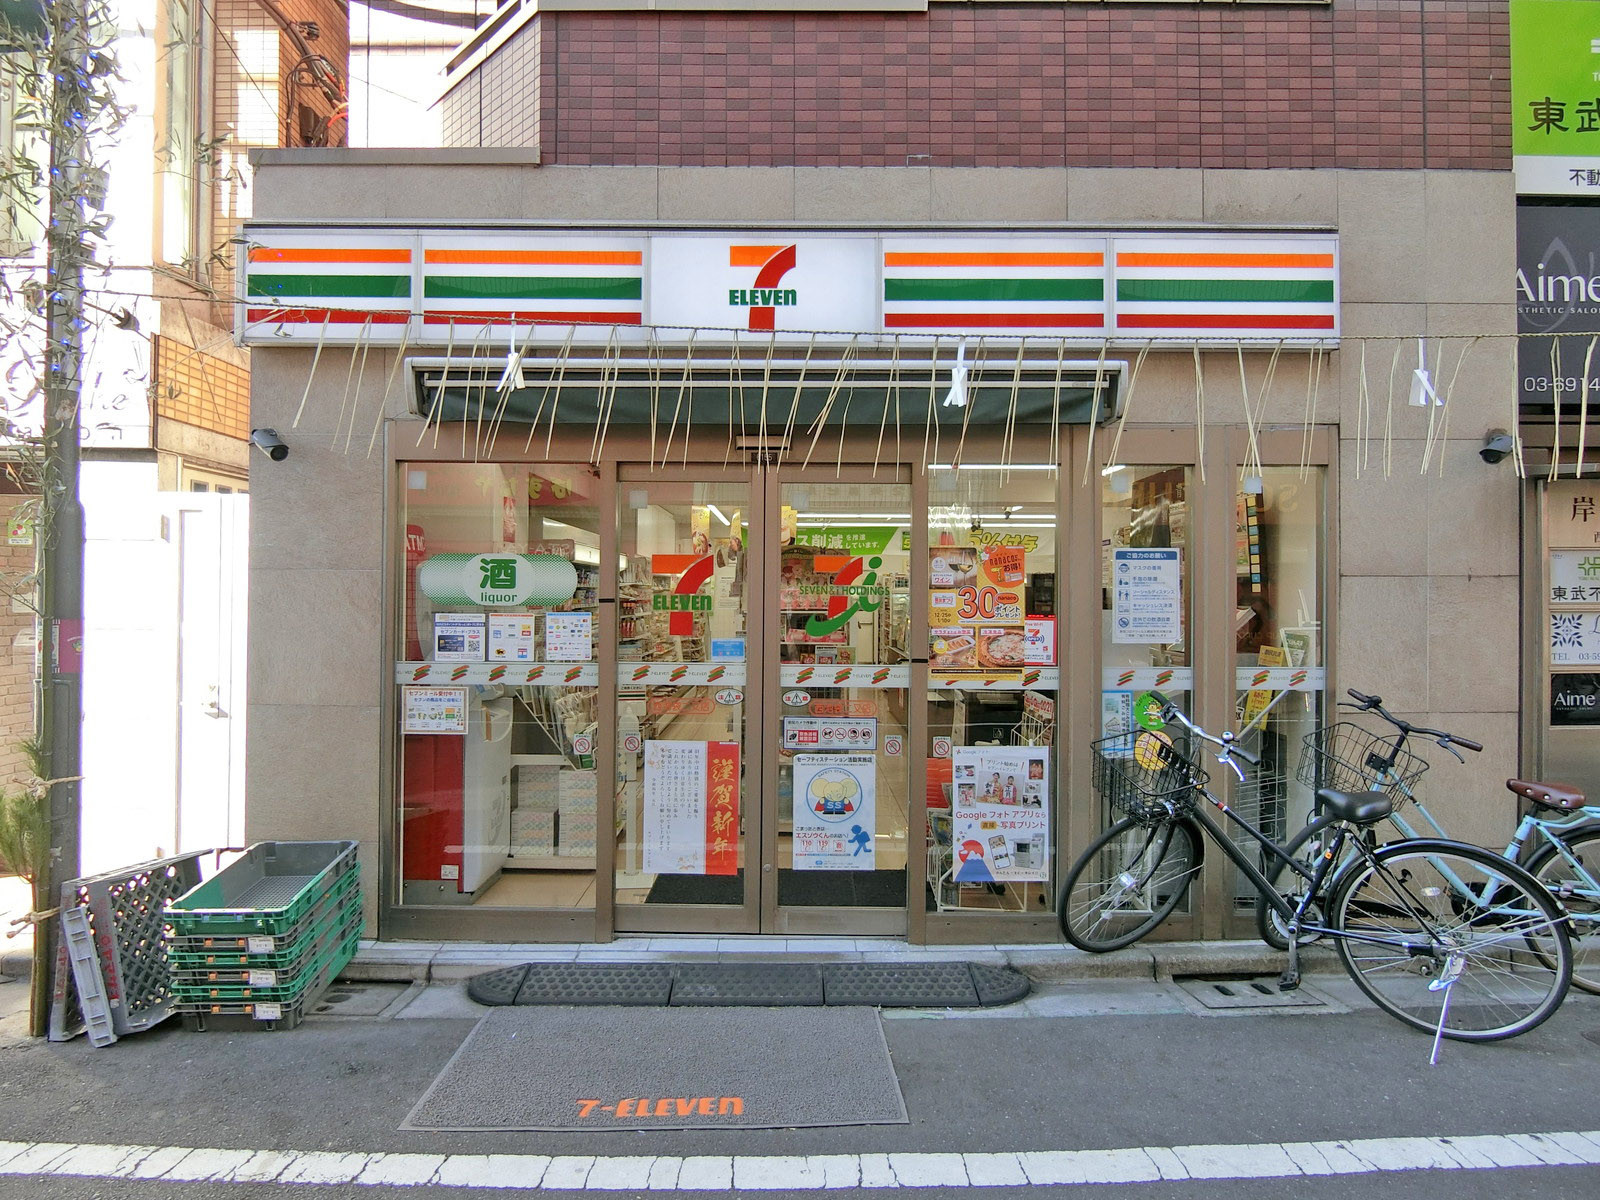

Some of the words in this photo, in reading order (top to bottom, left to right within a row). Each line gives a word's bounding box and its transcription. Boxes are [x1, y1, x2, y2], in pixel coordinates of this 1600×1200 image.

[1571, 496, 1596, 522] 岸
[480, 558, 517, 589] 酒
[842, 585, 890, 596] HOLDINGS
[480, 592, 518, 604] liquor
[957, 586, 998, 619] 30
[1552, 653, 1570, 661] TEL
[1554, 692, 1596, 706] Aime
[710, 758, 735, 861] 謹賀新年
[827, 801, 842, 809] SS
[956, 811, 987, 820] Google
[1012, 810, 1046, 818] アプリなら
[1001, 821, 1046, 829] 写真プリント
